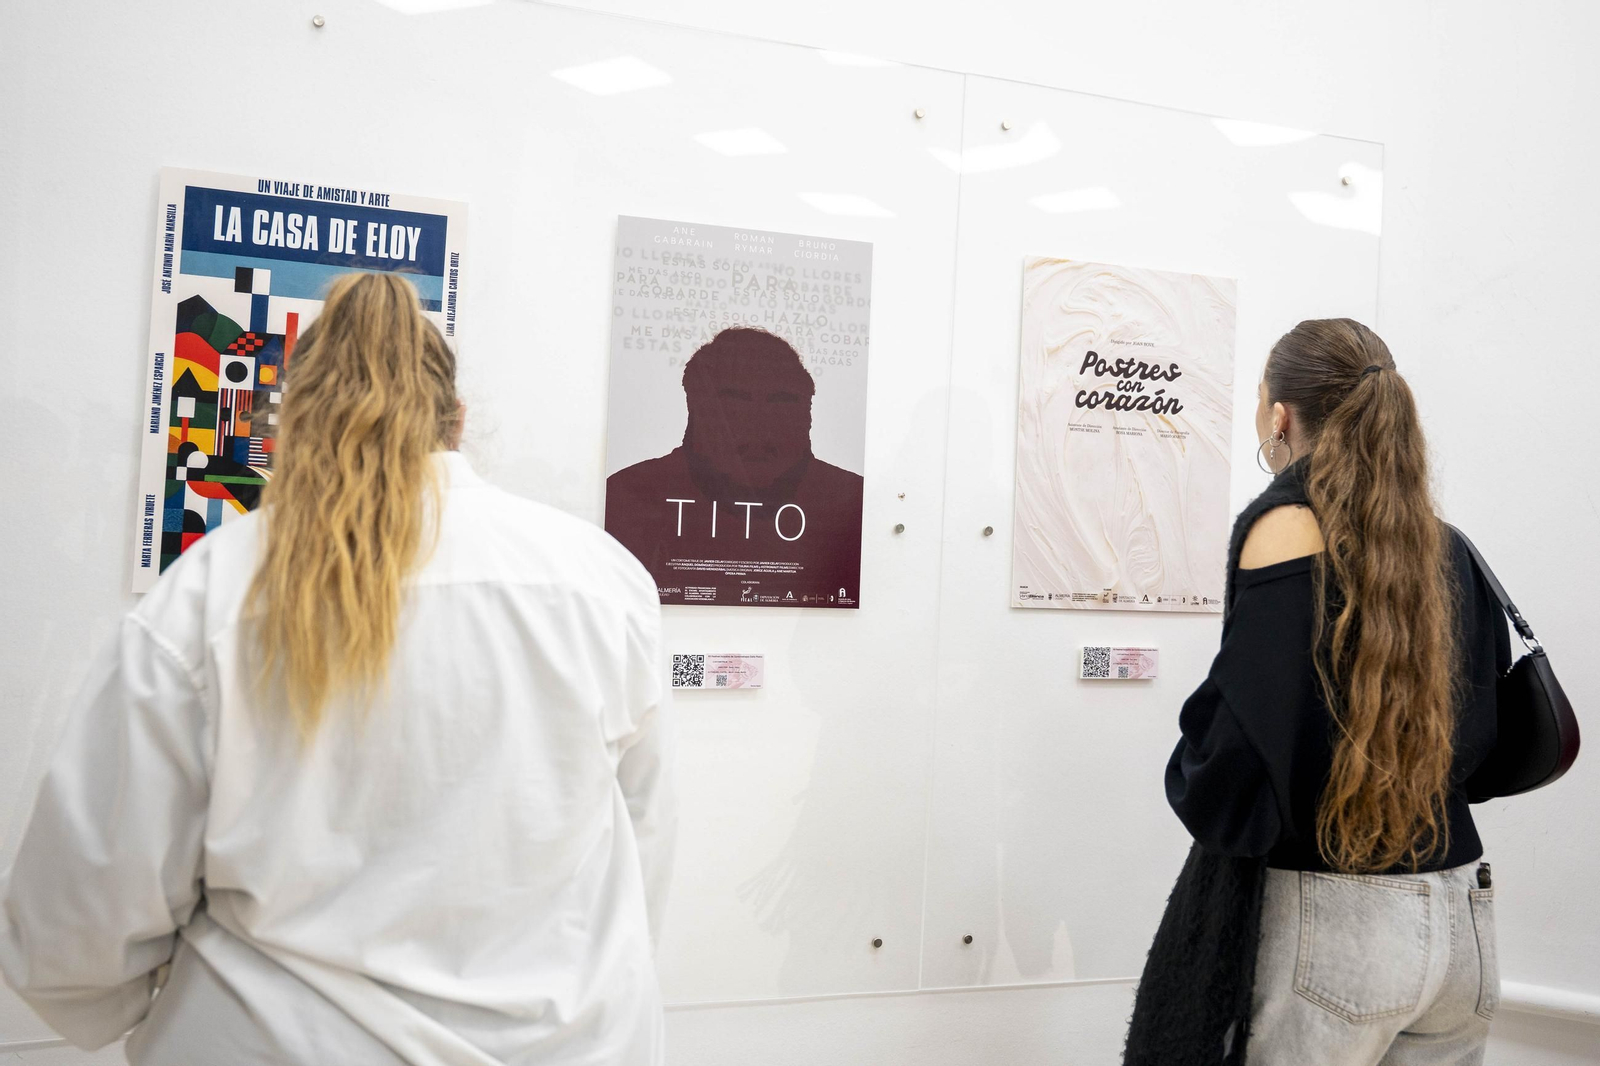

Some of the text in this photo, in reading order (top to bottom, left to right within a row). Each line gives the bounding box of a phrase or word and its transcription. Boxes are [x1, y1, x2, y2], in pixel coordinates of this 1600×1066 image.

[258, 179, 390, 207] UN VIAJE DE AMISTAD Y ARTE
[213, 204, 422, 262] LA CASA DE ELOY
[673, 226, 696, 236] ANE
[734, 232, 775, 244] ROMAN
[160, 203, 177, 294] JOSÉ ANTONIO MARÍN MANSILLA
[654, 235, 713, 249] GABARAIN
[734, 244, 773, 254] RYMAR
[798, 239, 836, 251] BRUNO
[793, 250, 839, 262] CIORDIA
[448, 268, 459, 290] CANTOS
[616, 271, 660, 286] PARA
[648, 267, 669, 277] DAS
[802, 267, 862, 284] LLORES
[732, 271, 797, 293] PARA
[640, 284, 720, 301] COBARDE
[733, 286, 820, 304] ESTAS SOLO
[446, 291, 457, 322] ALEJANDRA
[673, 306, 759, 323] ESTAS SOLO
[764, 309, 829, 328] HAZLO
[446, 322, 455, 337] LARA
[630, 325, 653, 337] ME
[661, 327, 693, 340] DAS
[775, 323, 815, 338] PARA
[623, 336, 682, 353] ESTAS
[809, 347, 828, 356] DAS
[832, 349, 859, 358] ASCO
[810, 355, 853, 367] HAGAS
[1078, 350, 1182, 382] Postres
[149, 352, 165, 434] MARIANO JIMÉNEZ ESPARCIA
[1116, 379, 1146, 393] con
[1074, 388, 1184, 415] corazón
[665, 498, 806, 542] TITO
[141, 494, 156, 568] MARTA FERRERAS VIRUETE
